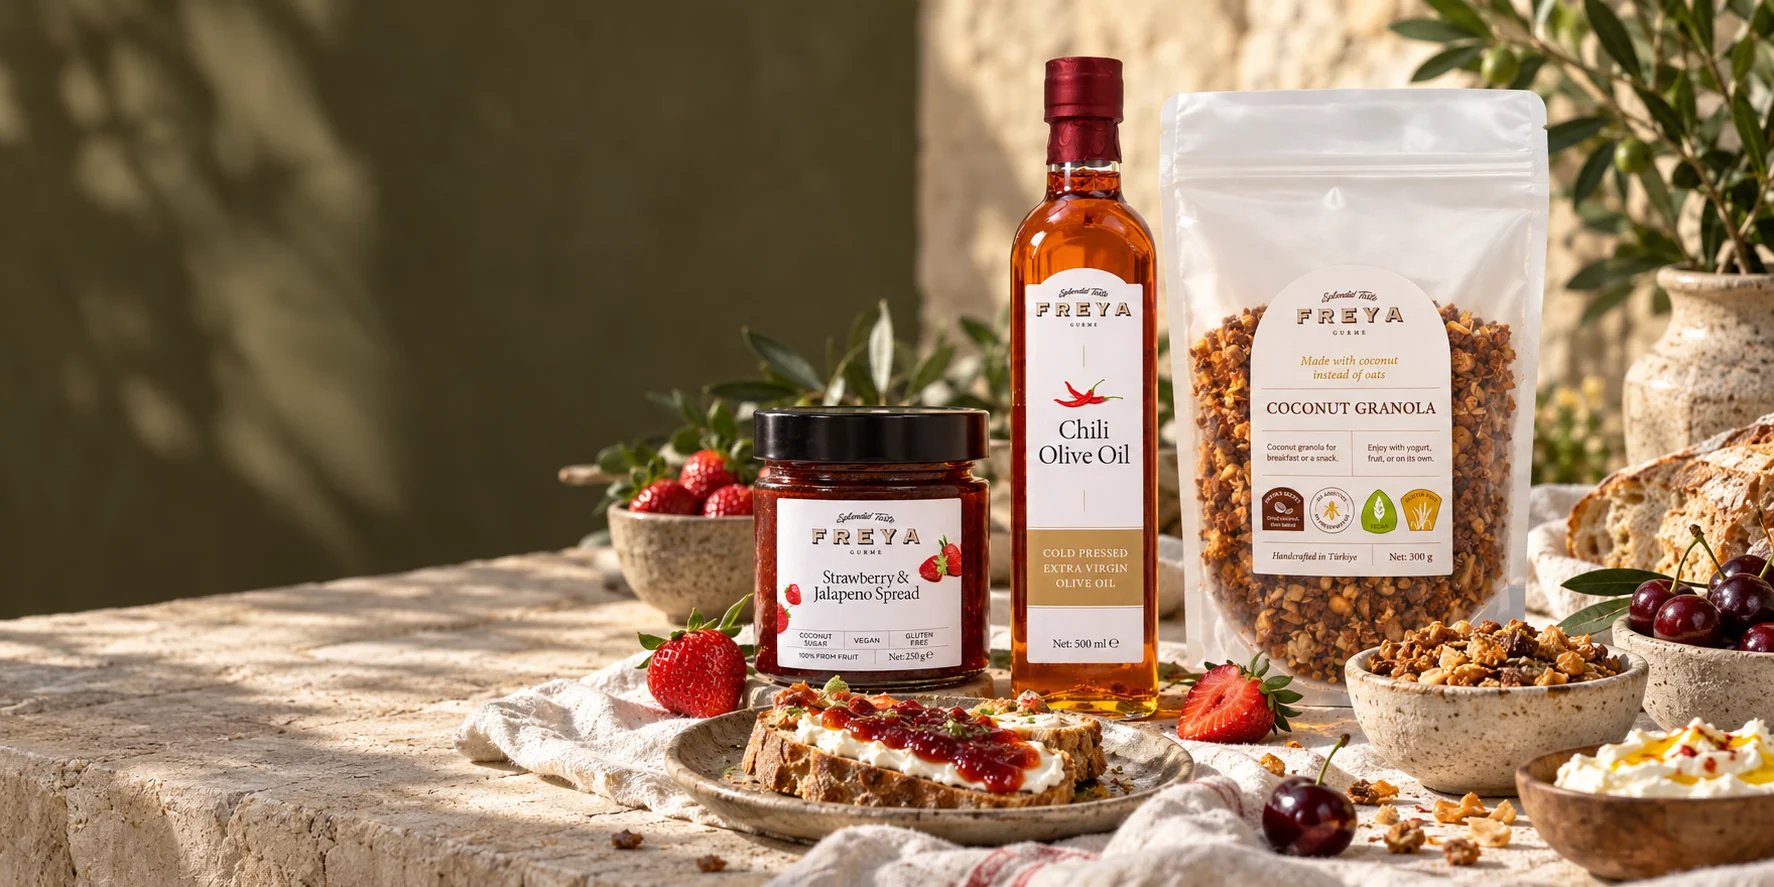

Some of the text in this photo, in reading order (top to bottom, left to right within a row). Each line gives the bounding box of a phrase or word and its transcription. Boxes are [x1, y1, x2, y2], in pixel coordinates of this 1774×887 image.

[1058, 288, 1090, 298] Splendid
[1321, 290, 1378, 303] Splendid Taste
[1036, 302, 1131, 317] FREYA
[1296, 306, 1404, 324] FREYA
[1300, 355, 1399, 366] Made with coconut
[1313, 370, 1349, 380] instead
[1352, 369, 1364, 382] of
[1266, 402, 1436, 415] COCONUT GRANOLA
[1059, 419, 1109, 439] Chili
[1298, 443, 1325, 452] granola
[1368, 444, 1388, 454] Enjoy
[1406, 444, 1432, 453] yogurt,
[1039, 444, 1130, 464] Olive Oil
[1368, 455, 1384, 463] fruit,
[836, 512, 895, 524] Splendid Taste
[812, 528, 920, 545] FREYA
[1042, 548, 1128, 558] COLD PRESSED
[1272, 552, 1317, 562] Handcrafted
[1328, 552, 1357, 563] Türkiye
[1389, 553, 1433, 563] Net: 300 g
[1043, 564, 1128, 573] EXTRA VIRGIN
[822, 570, 909, 588] Strawberry &
[1056, 579, 1115, 588] OLIVE OIL
[814, 586, 920, 604] Jalapeno Spread
[1053, 639, 1072, 648] Net:
[1074, 639, 1092, 648] 500
[1094, 639, 1106, 648] ml
[888, 652, 905, 661] Net:
